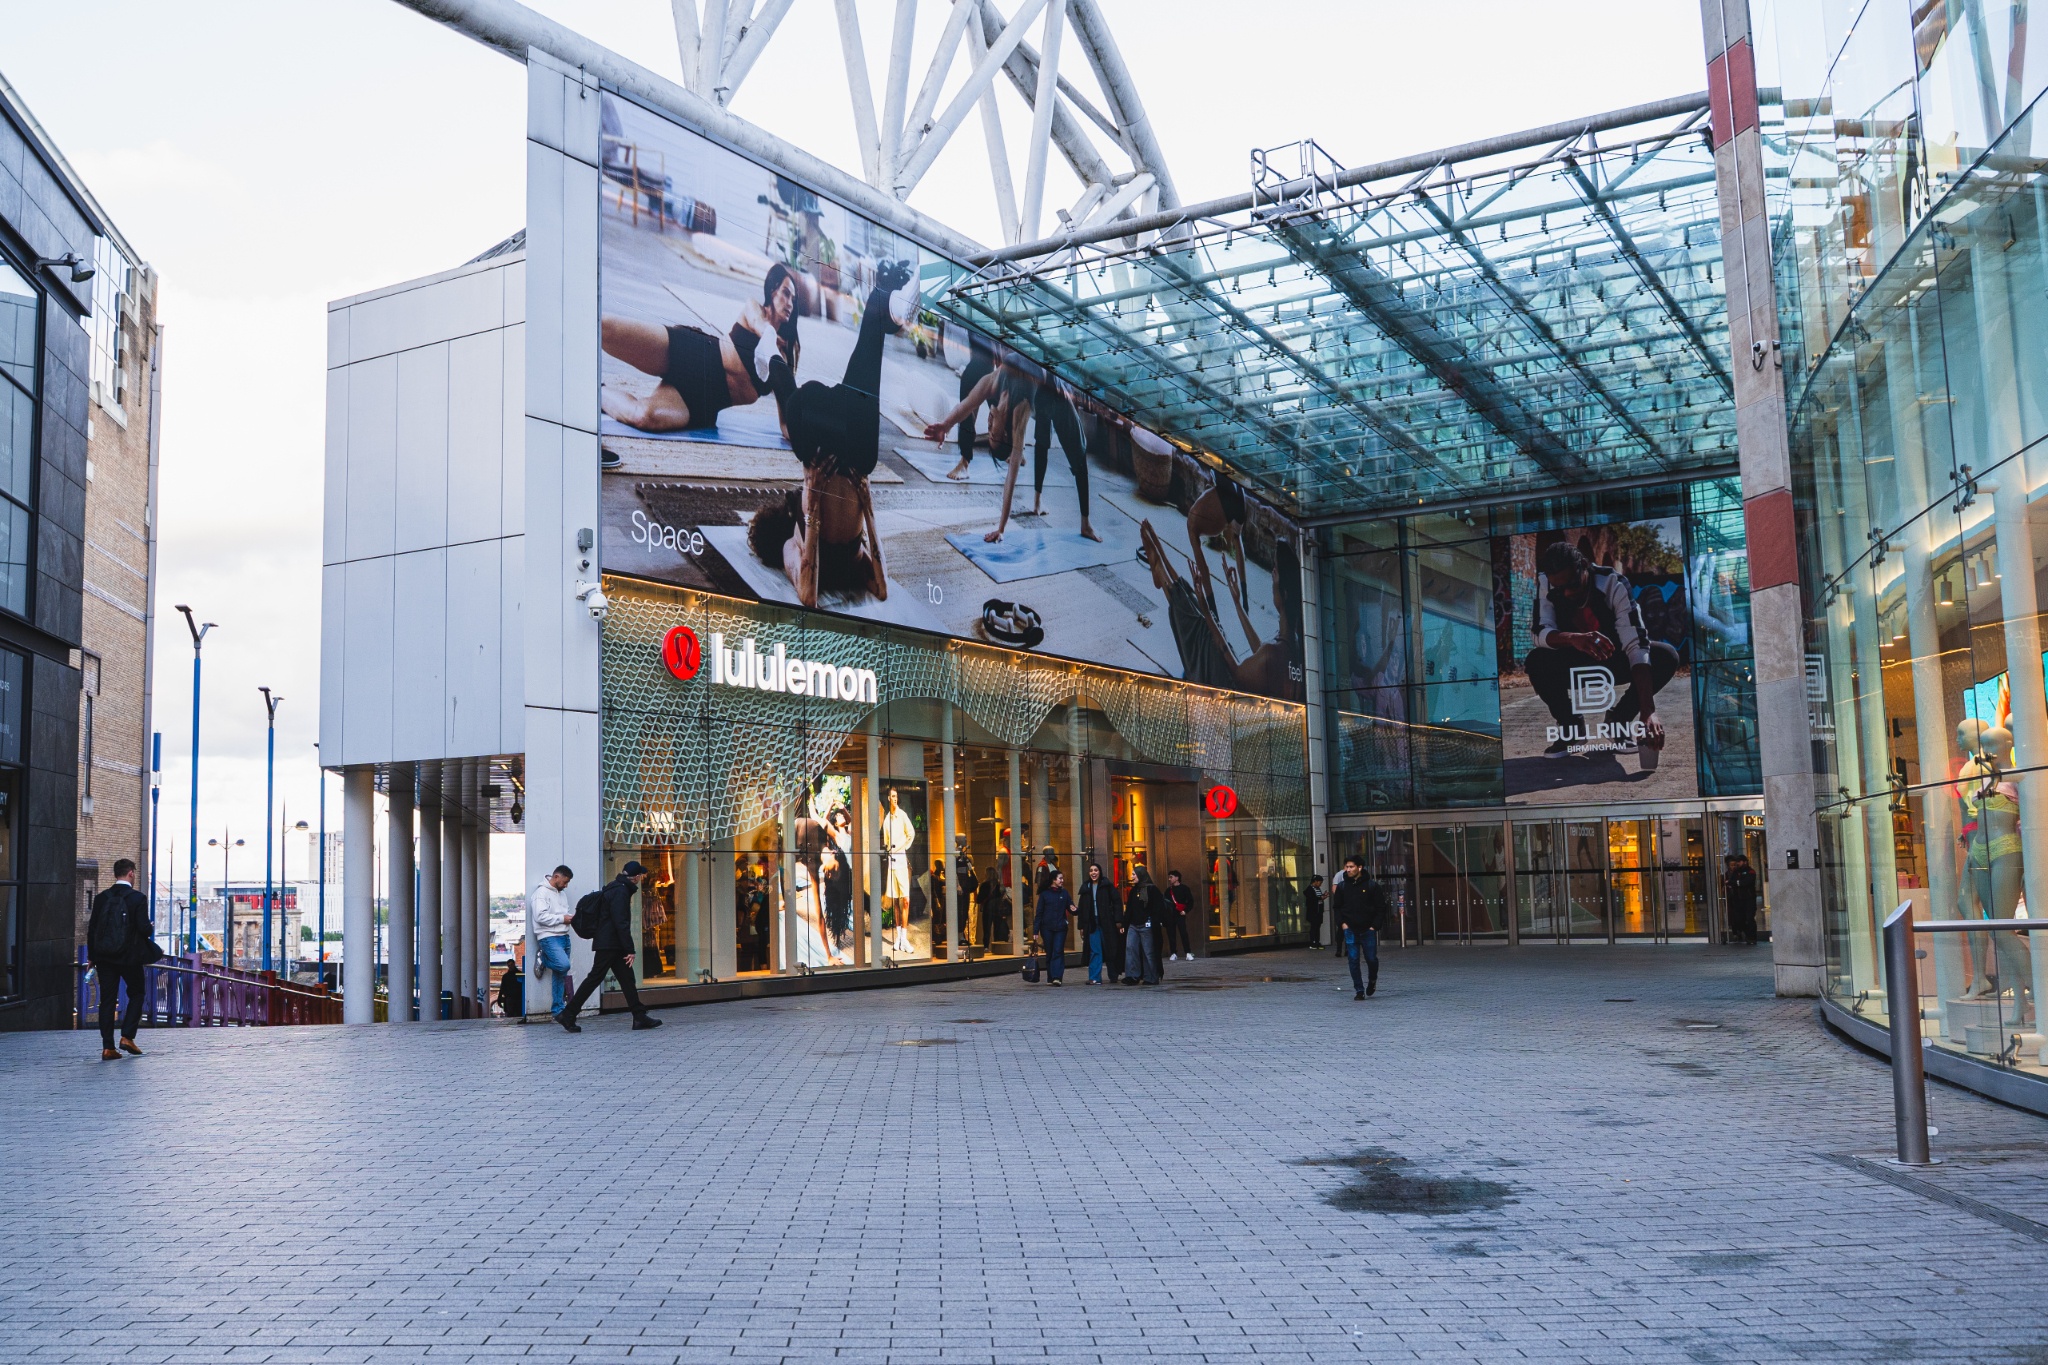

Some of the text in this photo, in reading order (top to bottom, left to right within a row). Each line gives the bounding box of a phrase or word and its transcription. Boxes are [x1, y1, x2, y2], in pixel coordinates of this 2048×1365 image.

[631, 510, 704, 555] Space
[926, 578, 943, 605] to
[711, 632, 877, 703] lululemon
[1288, 661, 1303, 682] feel
[1546, 720, 1647, 743] BULLRING
[1567, 742, 1627, 753] BIRMINGHAM
